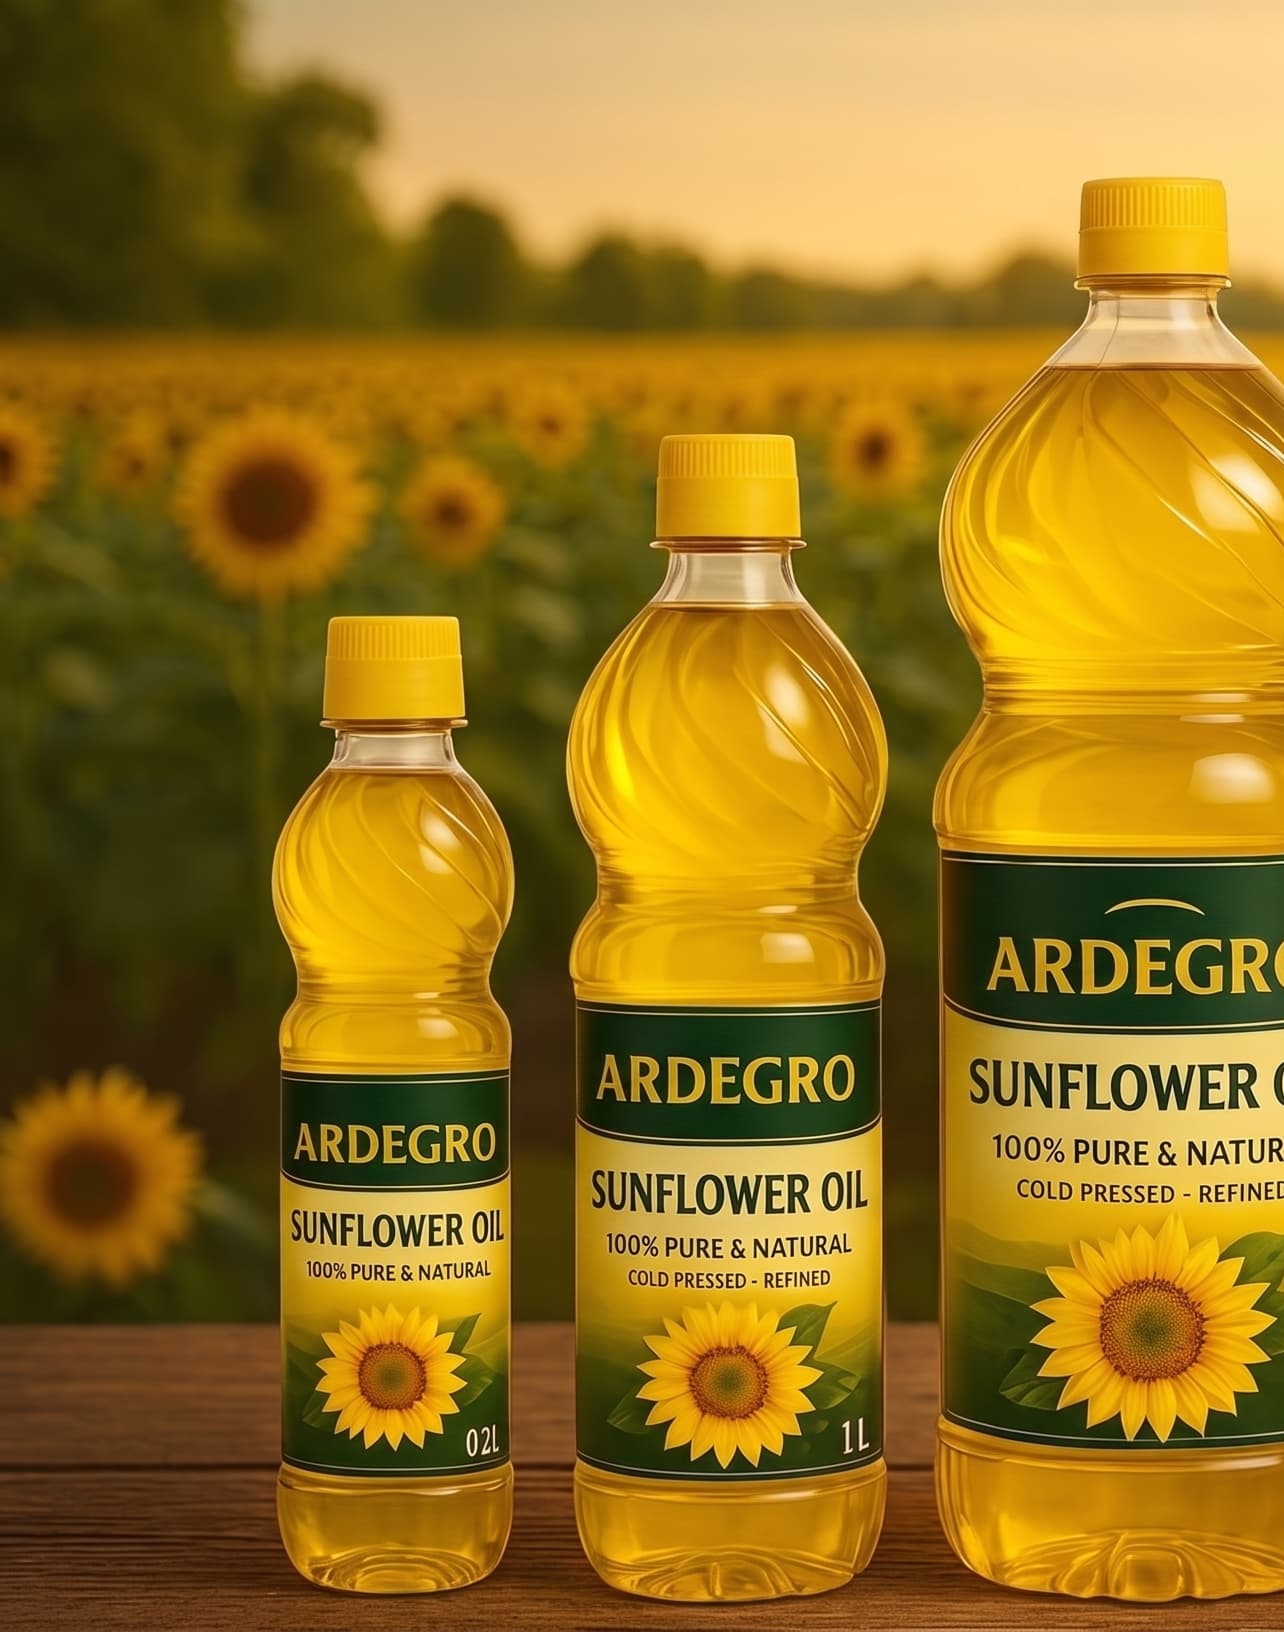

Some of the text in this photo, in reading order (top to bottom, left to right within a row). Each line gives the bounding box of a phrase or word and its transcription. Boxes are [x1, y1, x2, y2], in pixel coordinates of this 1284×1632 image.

[596, 1054, 855, 1105] ARDEGRO
[969, 1057, 1260, 1112] SUNFLOWER
[294, 1122, 496, 1165] ARDEGRO
[992, 1133, 1065, 1163] 100%
[1073, 1139, 1149, 1165] PURE
[1158, 1140, 1177, 1166] &
[591, 1170, 868, 1216] SUNFLOWER OIL
[1017, 1179, 1073, 1201] COLD
[1080, 1183, 1175, 1204] PRESSED
[291, 1209, 504, 1248] SUNFLOWER OIL
[606, 1233, 852, 1259] 100% PURE & NATURAL
[307, 1260, 491, 1281] 100% PURE & NATURAL
[628, 1269, 669, 1287] COLD
[674, 1272, 746, 1289] PRESSED
[764, 1270, 831, 1288] REFINED
[841, 1417, 870, 1455] 1L
